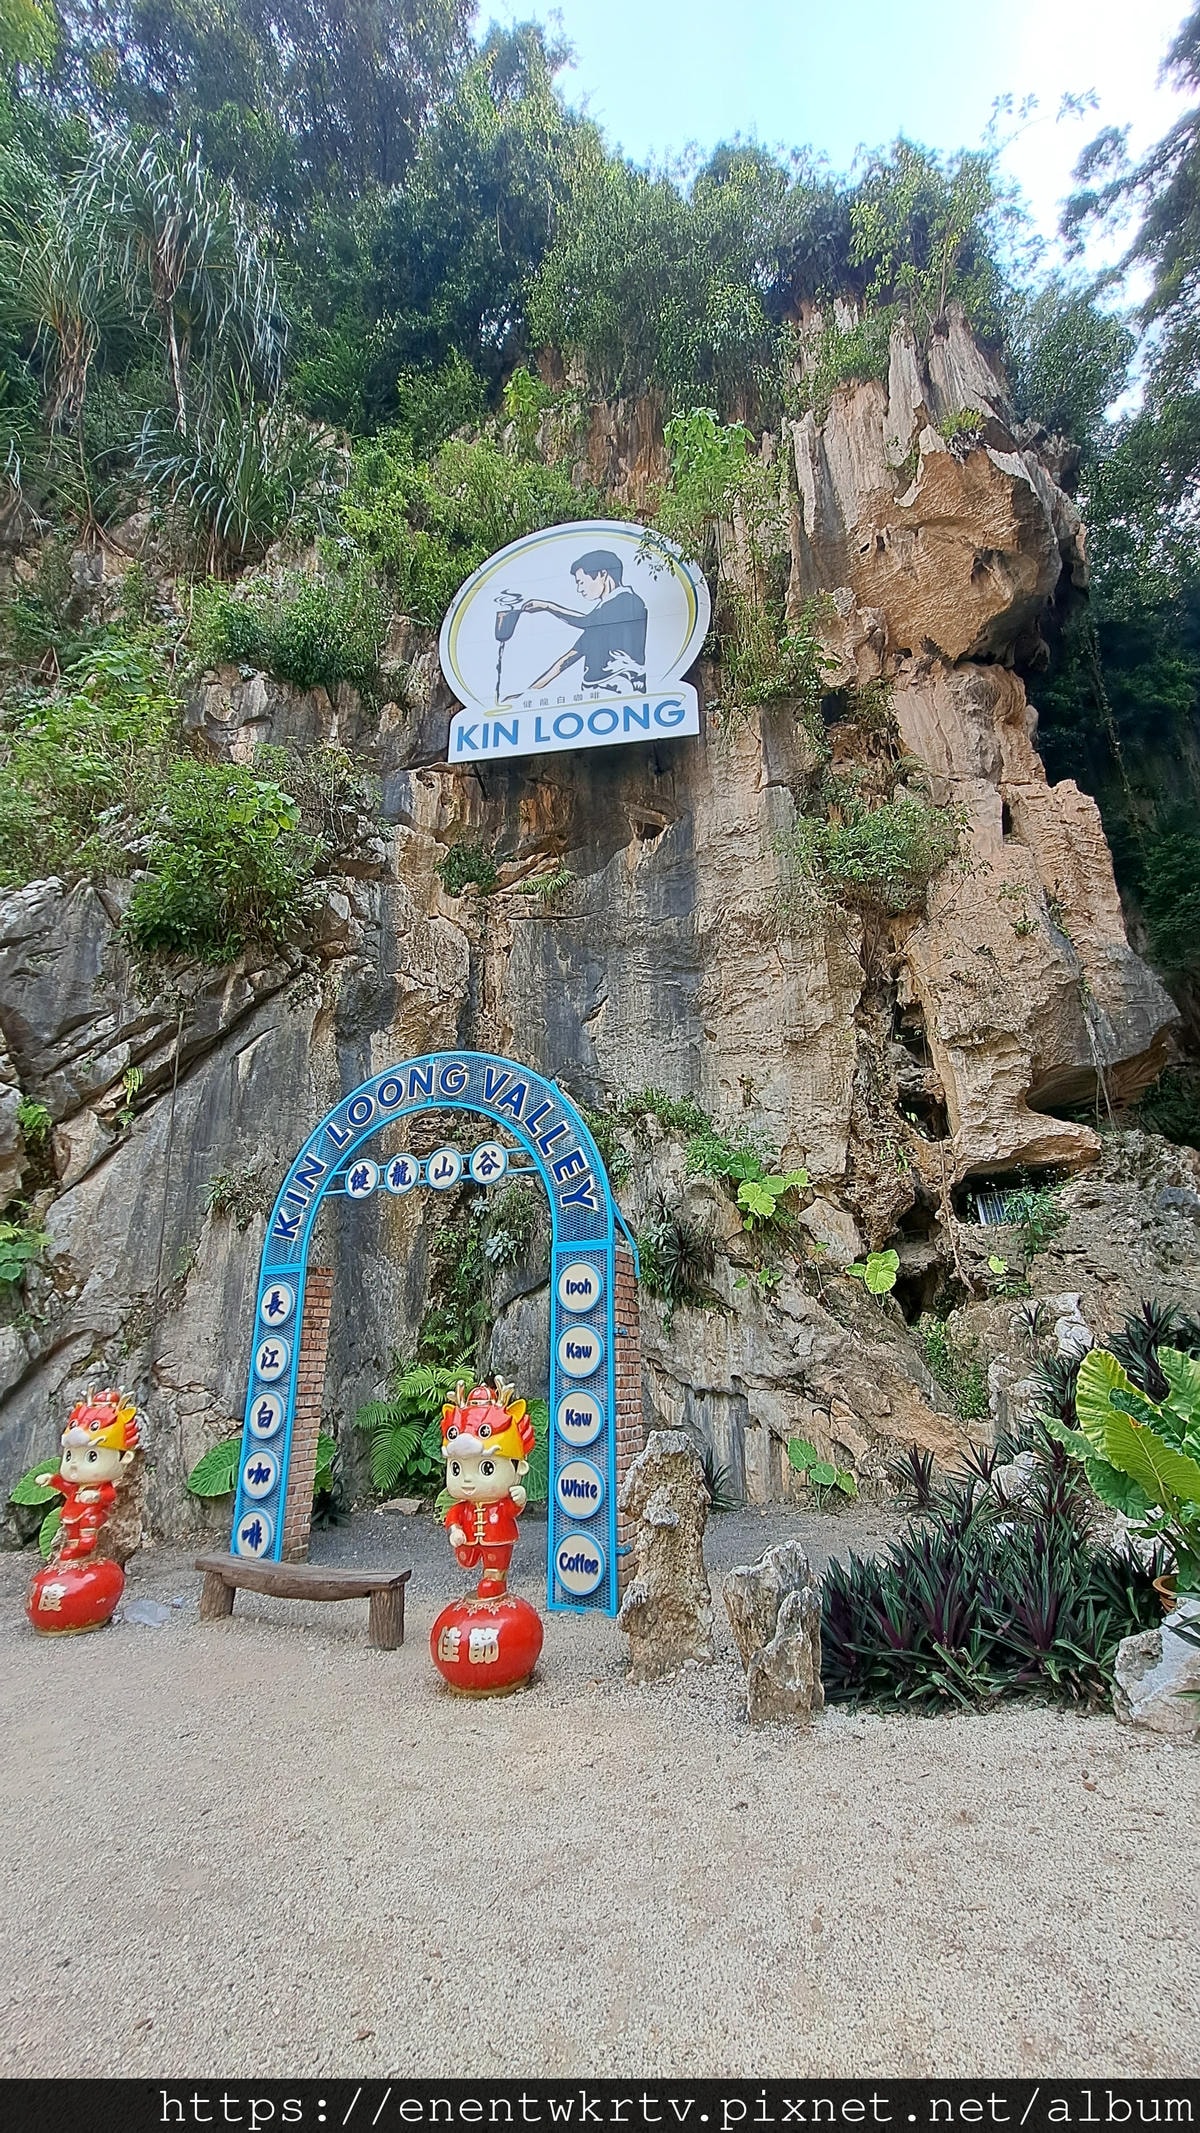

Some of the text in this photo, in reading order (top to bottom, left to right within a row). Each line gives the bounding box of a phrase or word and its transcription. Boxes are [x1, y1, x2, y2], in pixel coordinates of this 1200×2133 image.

[456, 700, 685, 752] KIN LOONG
[274, 1062, 598, 1241] KIN LOONG VALLEY
[350, 1150, 500, 1192] 健龍山谷
[566, 1278, 592, 1296] Ipoh
[566, 1342, 593, 1359] Kaw
[241, 1290, 286, 1551] 長江白咖啡
[565, 1408, 593, 1427] Kaw
[560, 1479, 598, 1499] White
[559, 1552, 599, 1575] Coffee
